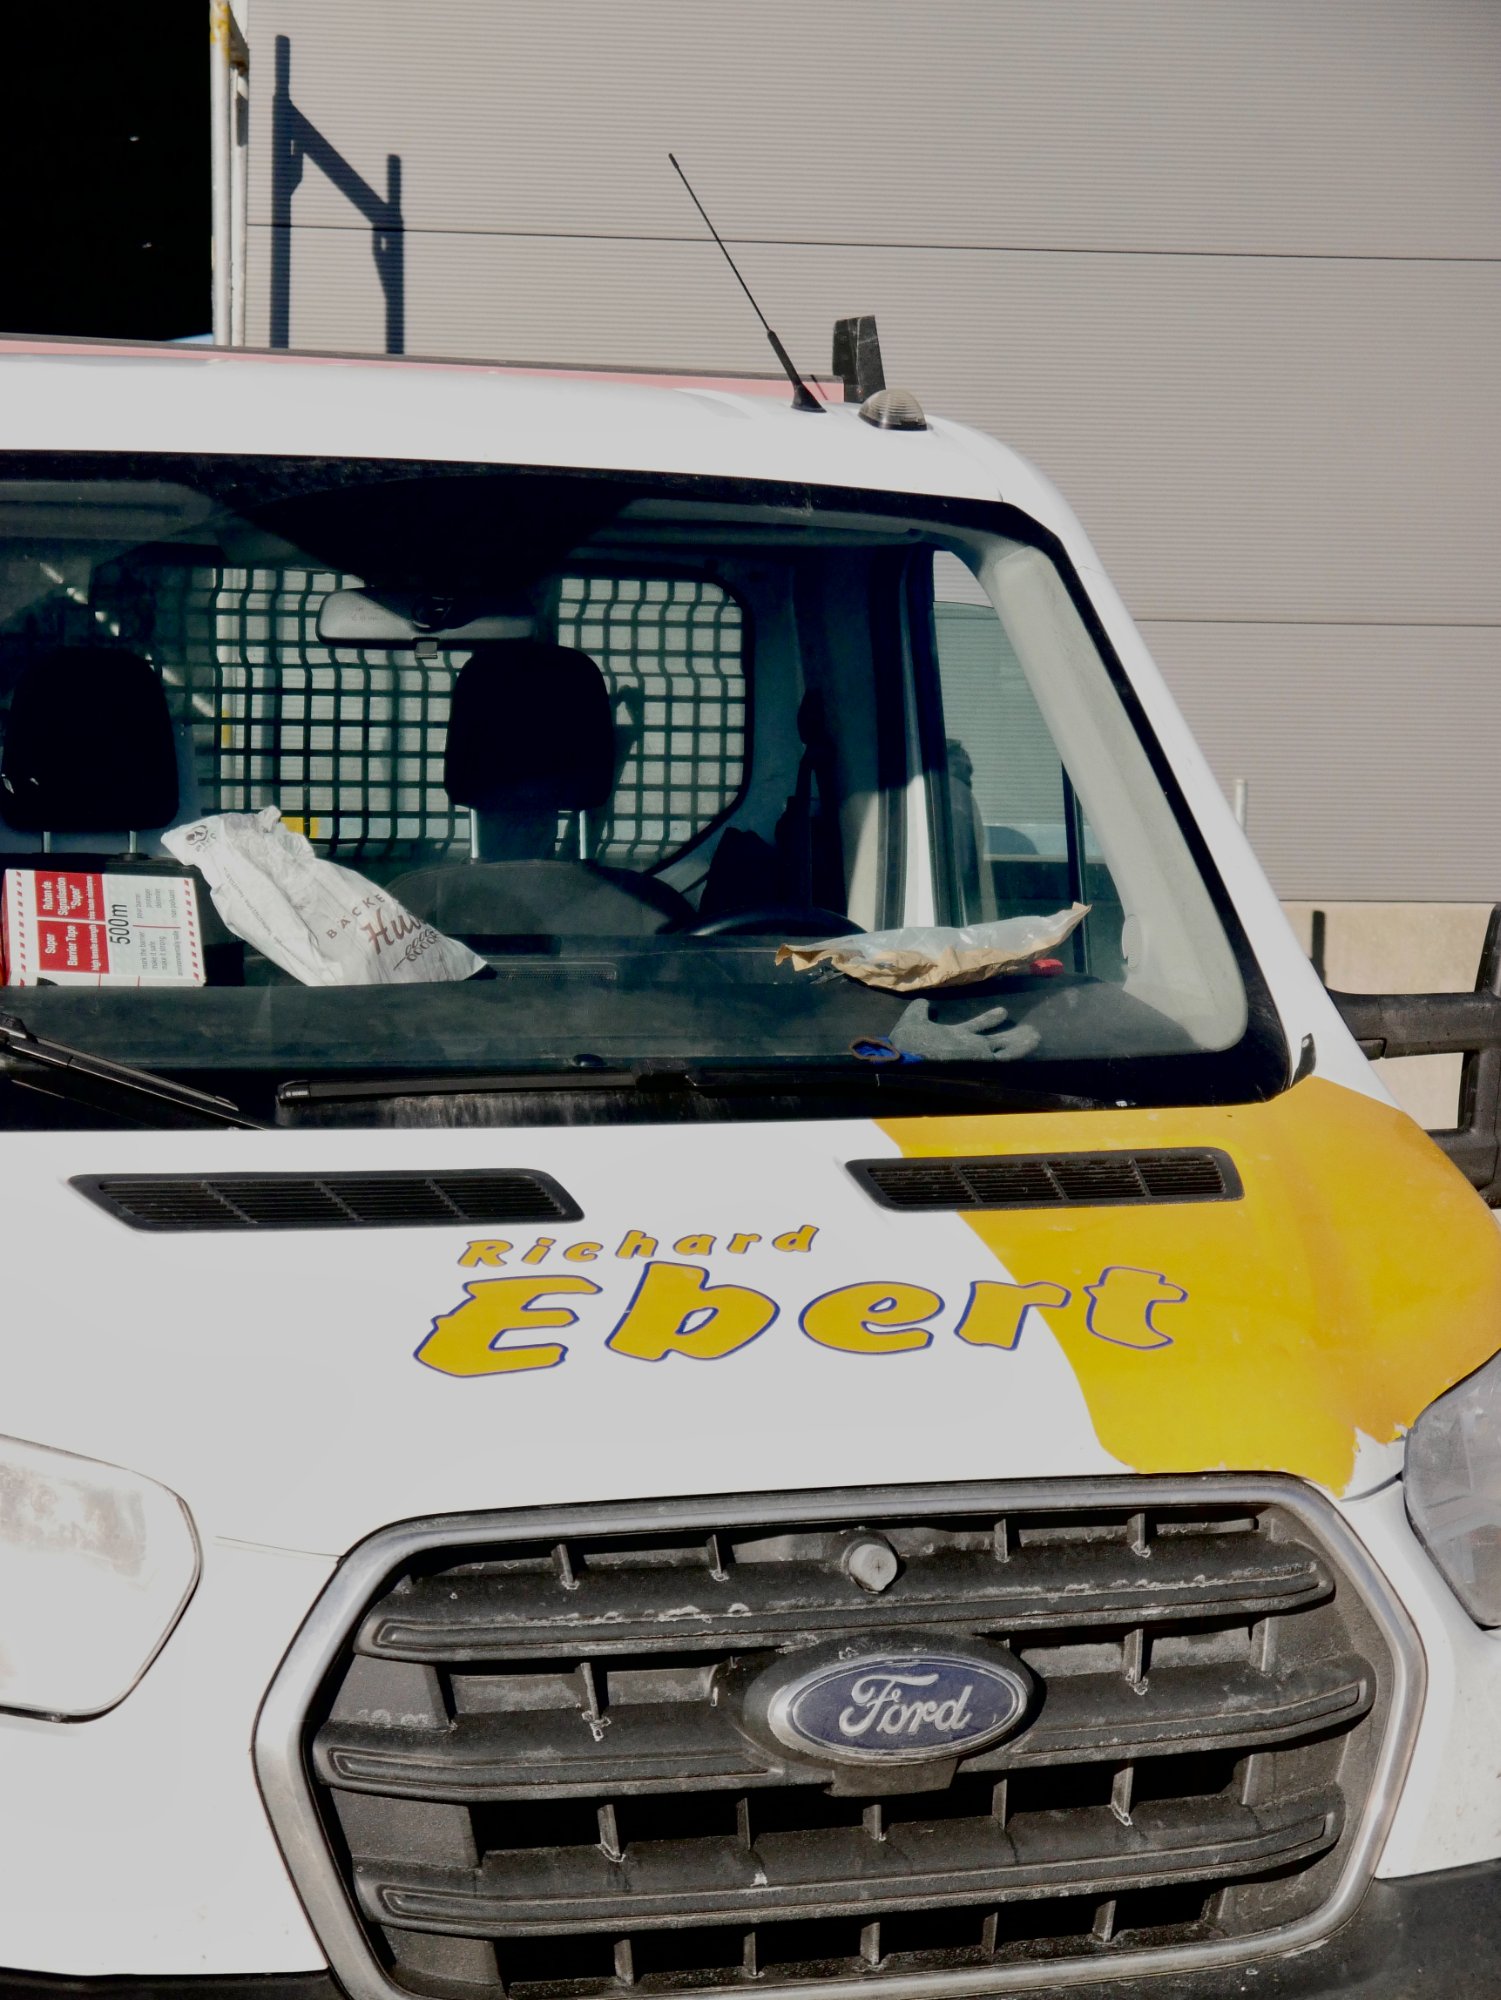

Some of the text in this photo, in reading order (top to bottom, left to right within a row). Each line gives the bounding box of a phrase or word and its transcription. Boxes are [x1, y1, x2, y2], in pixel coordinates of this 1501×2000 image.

[42, 890, 53, 910] Ruban
[56, 877, 70, 916] Signalisation
[45, 933, 58, 954] Super
[65, 925, 78, 966] Barrier Tape
[457, 1225, 820, 1268] Richard
[413, 1260, 1189, 1379] Ebert
[838, 1673, 974, 1737] Ford
